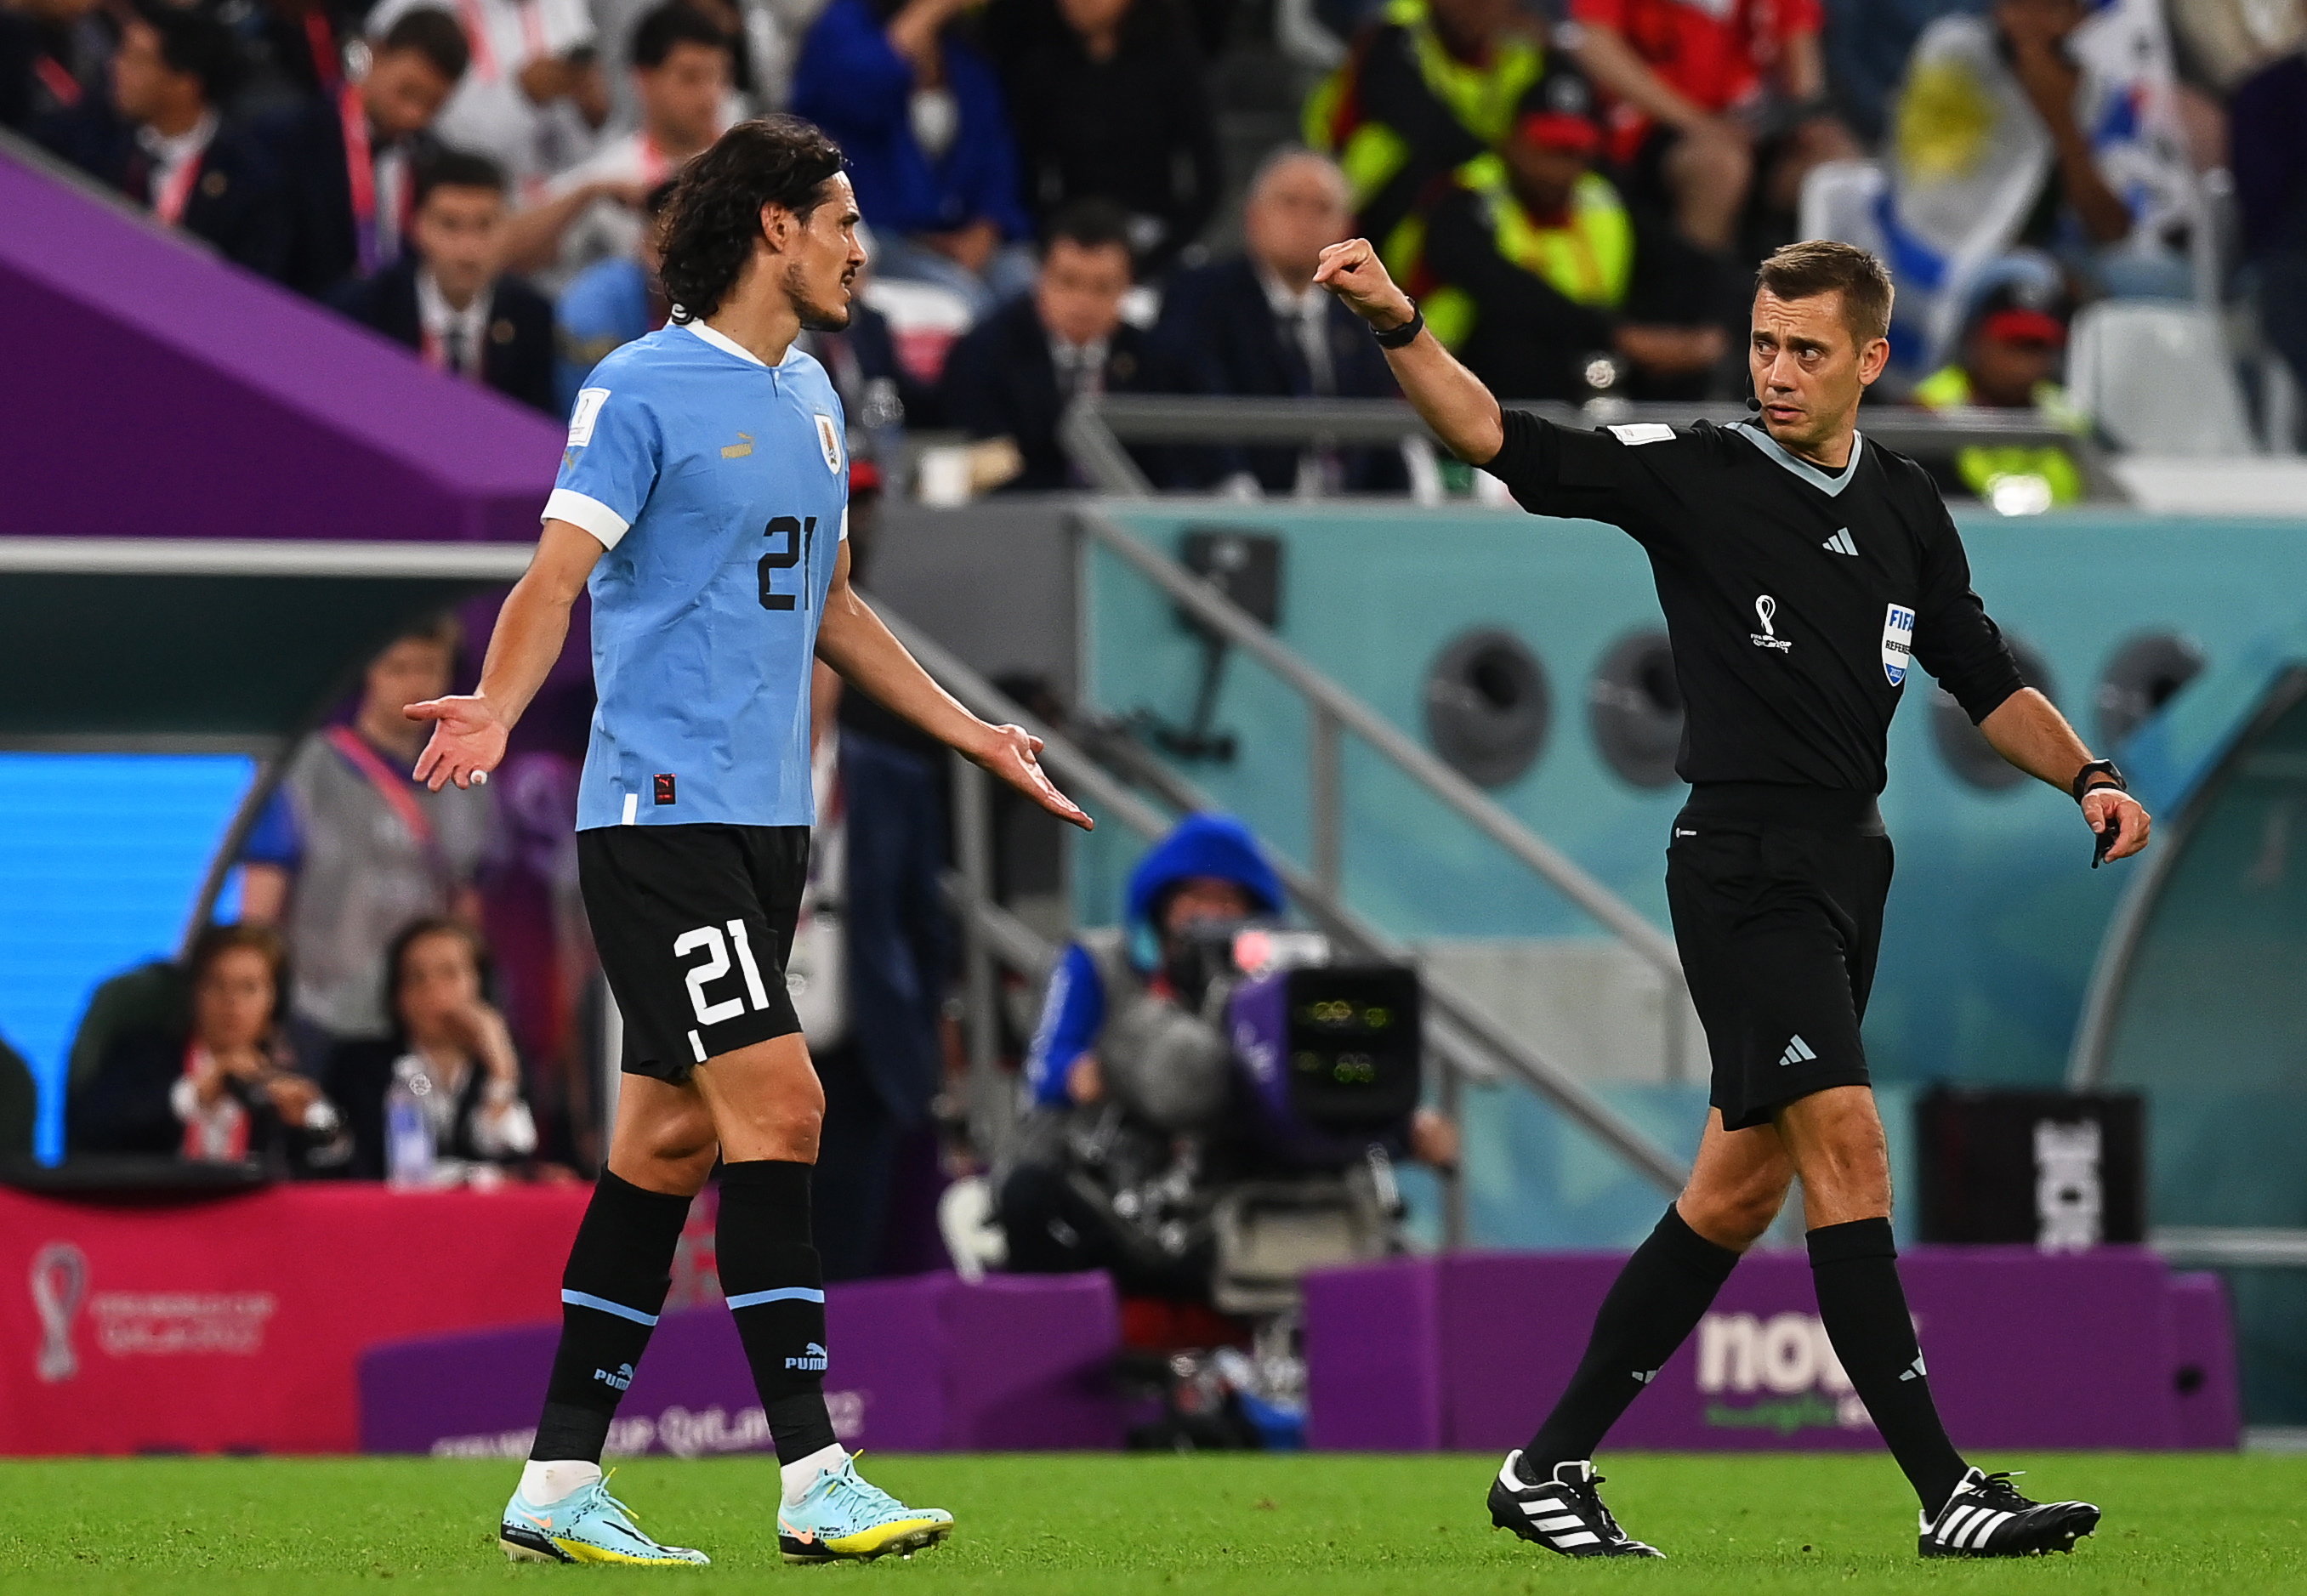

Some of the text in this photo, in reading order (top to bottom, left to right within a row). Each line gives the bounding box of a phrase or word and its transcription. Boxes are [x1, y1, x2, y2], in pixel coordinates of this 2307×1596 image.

[758, 516, 817, 611] 21
[1889, 610, 1914, 632] FIFA
[1885, 639, 1911, 655] REFERE
[673, 919, 770, 1025] 21
[594, 1368, 631, 1391] PUM
